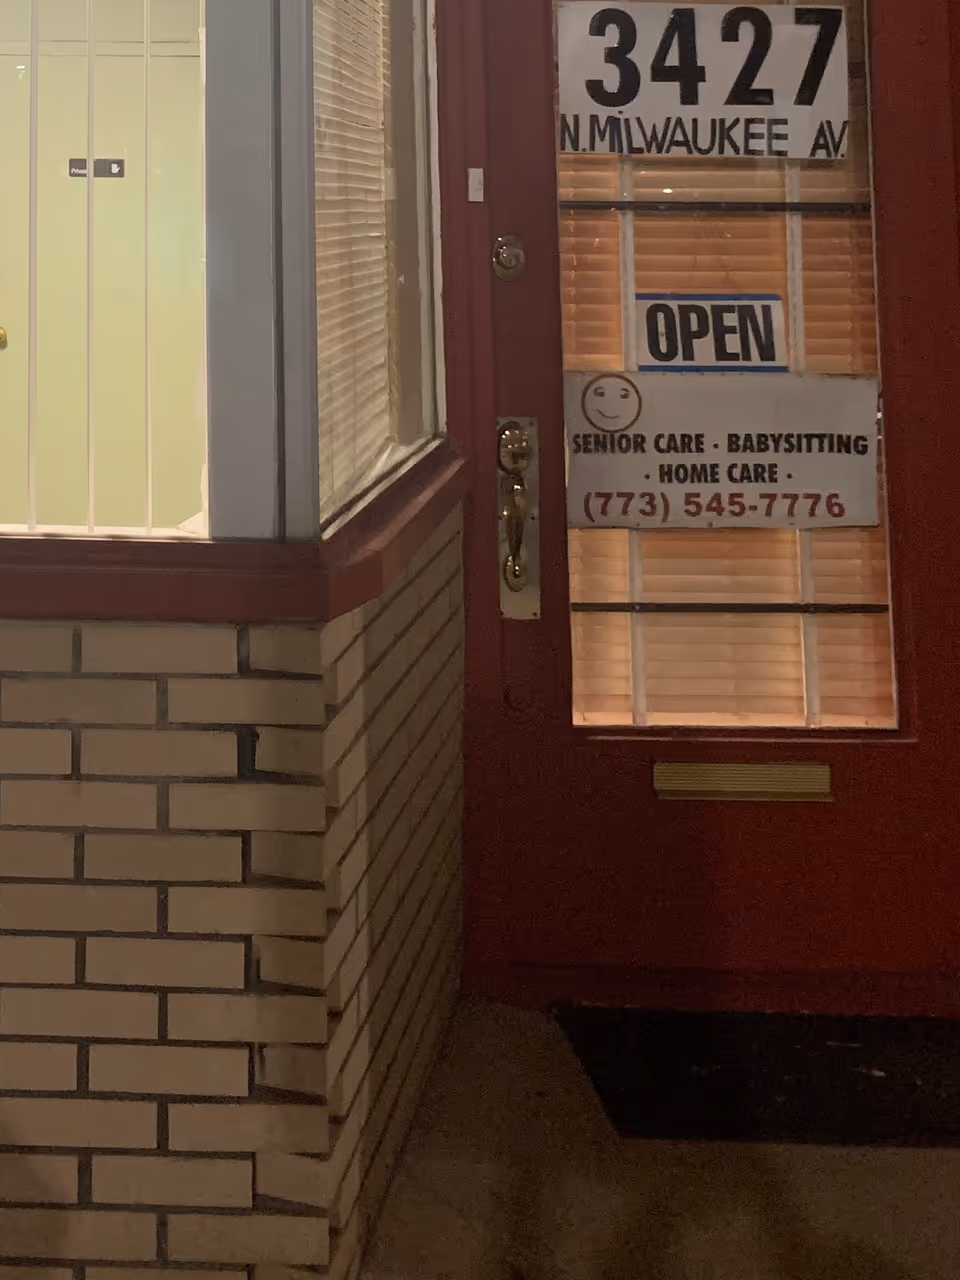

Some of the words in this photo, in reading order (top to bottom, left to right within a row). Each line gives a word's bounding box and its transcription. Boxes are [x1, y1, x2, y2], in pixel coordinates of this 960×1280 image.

[585, 7, 844, 108] 3427
[645, 302, 776, 363] OPEN
[572, 433, 647, 455] SENIOR
[653, 433, 705, 454] CARE
[727, 433, 869, 456] BABYSITTING
[659, 463, 720, 484] HOME
[727, 463, 778, 484] CARE
[583, 491, 670, 523] (773)
[683, 492, 846, 519] 545-7776
